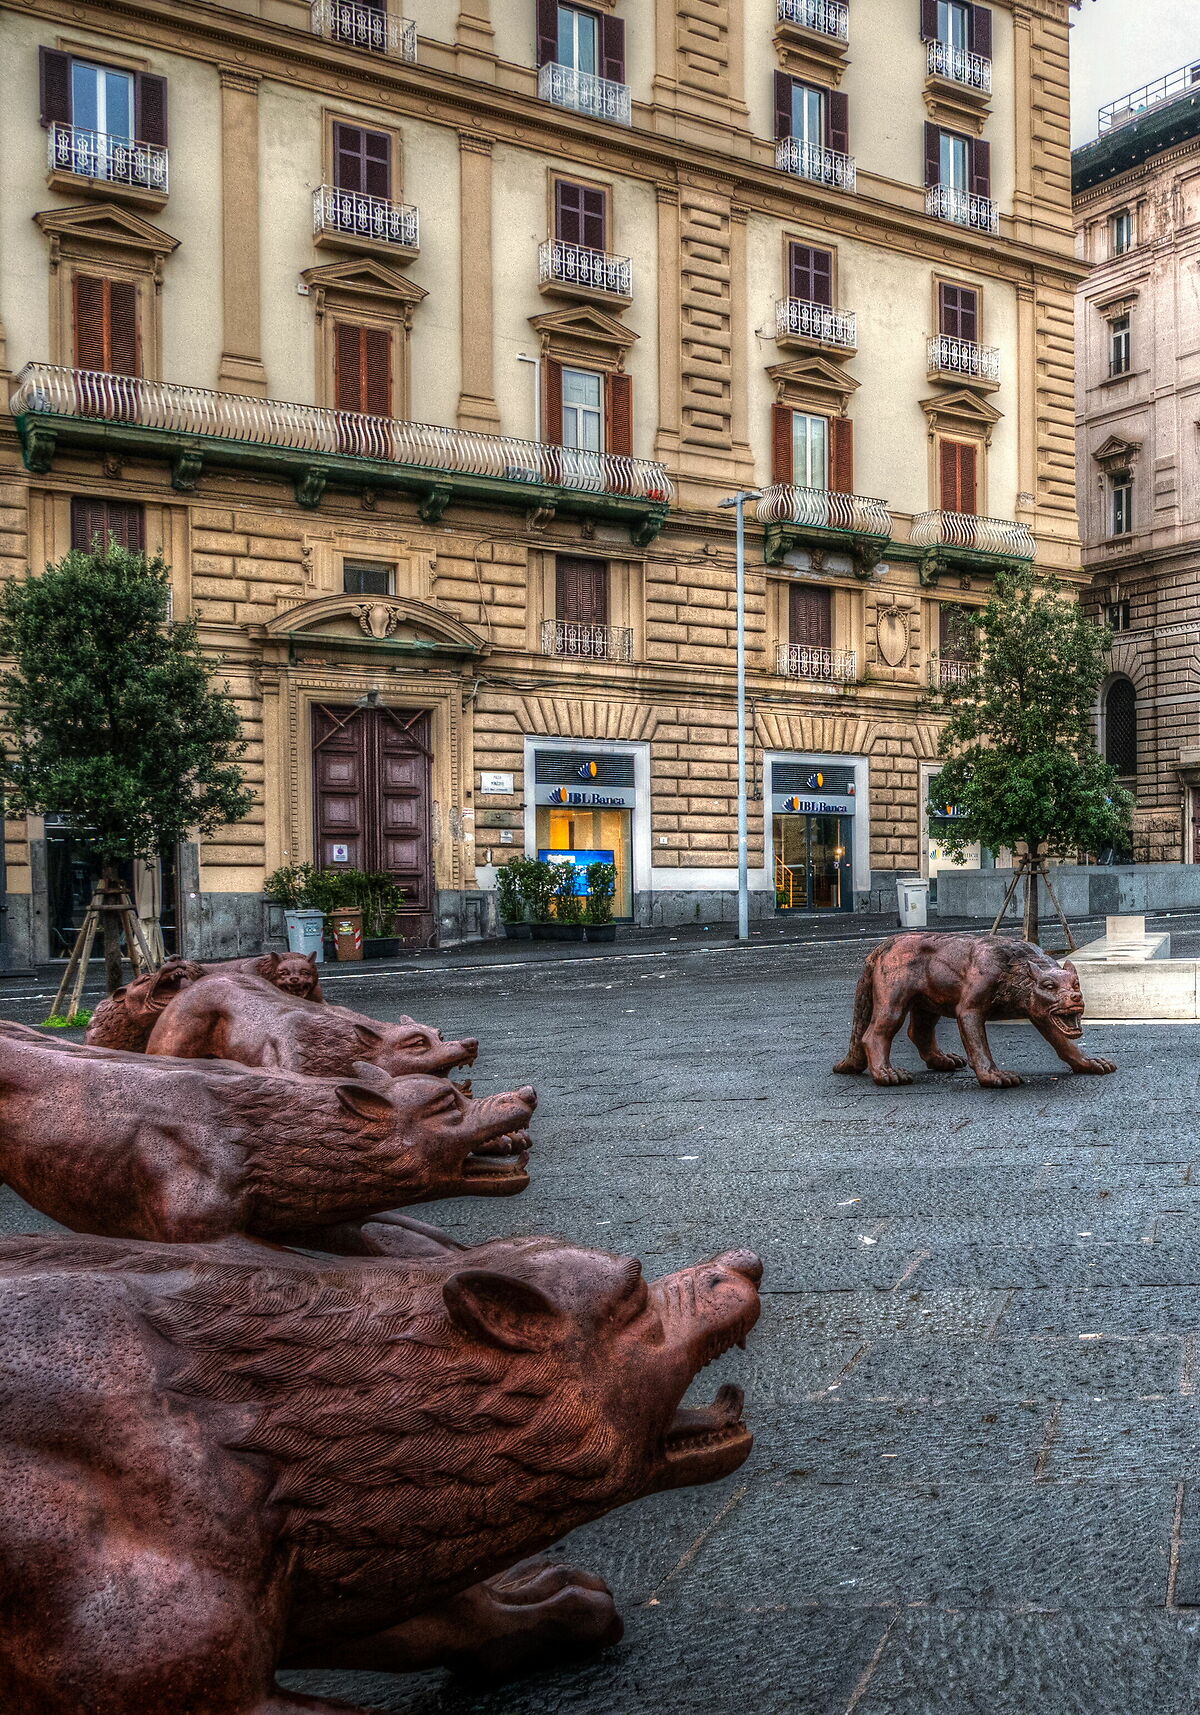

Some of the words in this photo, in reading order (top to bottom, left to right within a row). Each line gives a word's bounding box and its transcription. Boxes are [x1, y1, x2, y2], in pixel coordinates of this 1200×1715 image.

[568, 792, 591, 804] IBL
[592, 793, 625, 805] Banca
[799, 801, 819, 812] IBL
[819, 801, 848, 813] Banca
